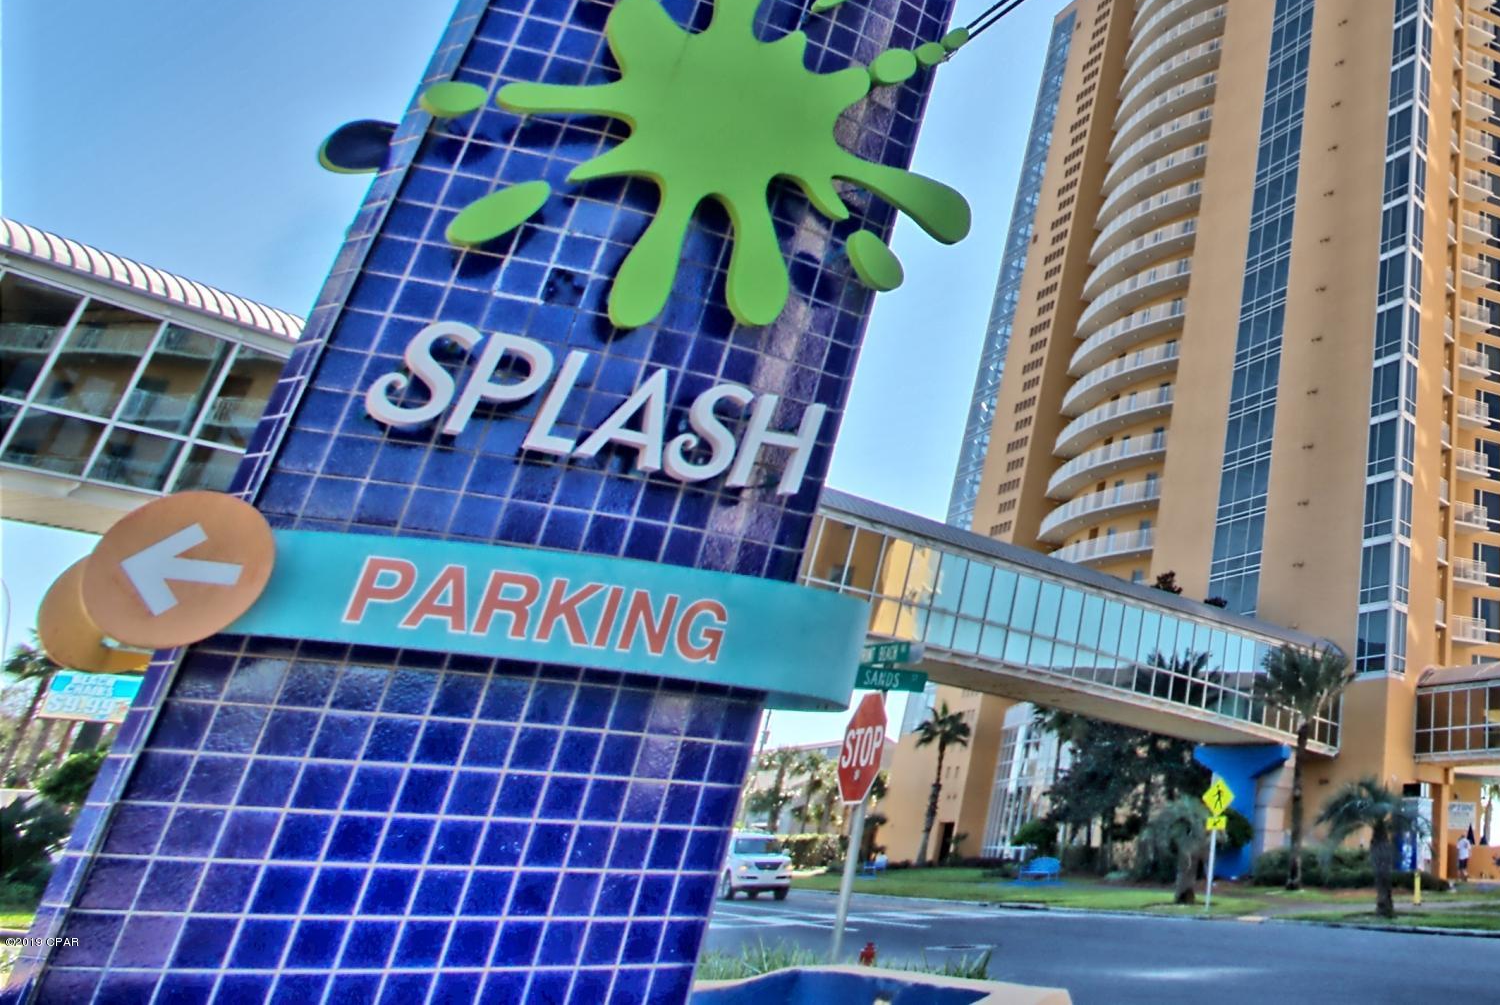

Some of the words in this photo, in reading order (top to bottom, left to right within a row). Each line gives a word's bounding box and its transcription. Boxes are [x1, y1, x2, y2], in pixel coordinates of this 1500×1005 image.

[364, 320, 827, 495] SPLASH
[342, 554, 729, 665] PARKING
[863, 669, 901, 688] SANDS
[46, 695, 114, 715] $9.99
[841, 725, 884, 769] STOP
